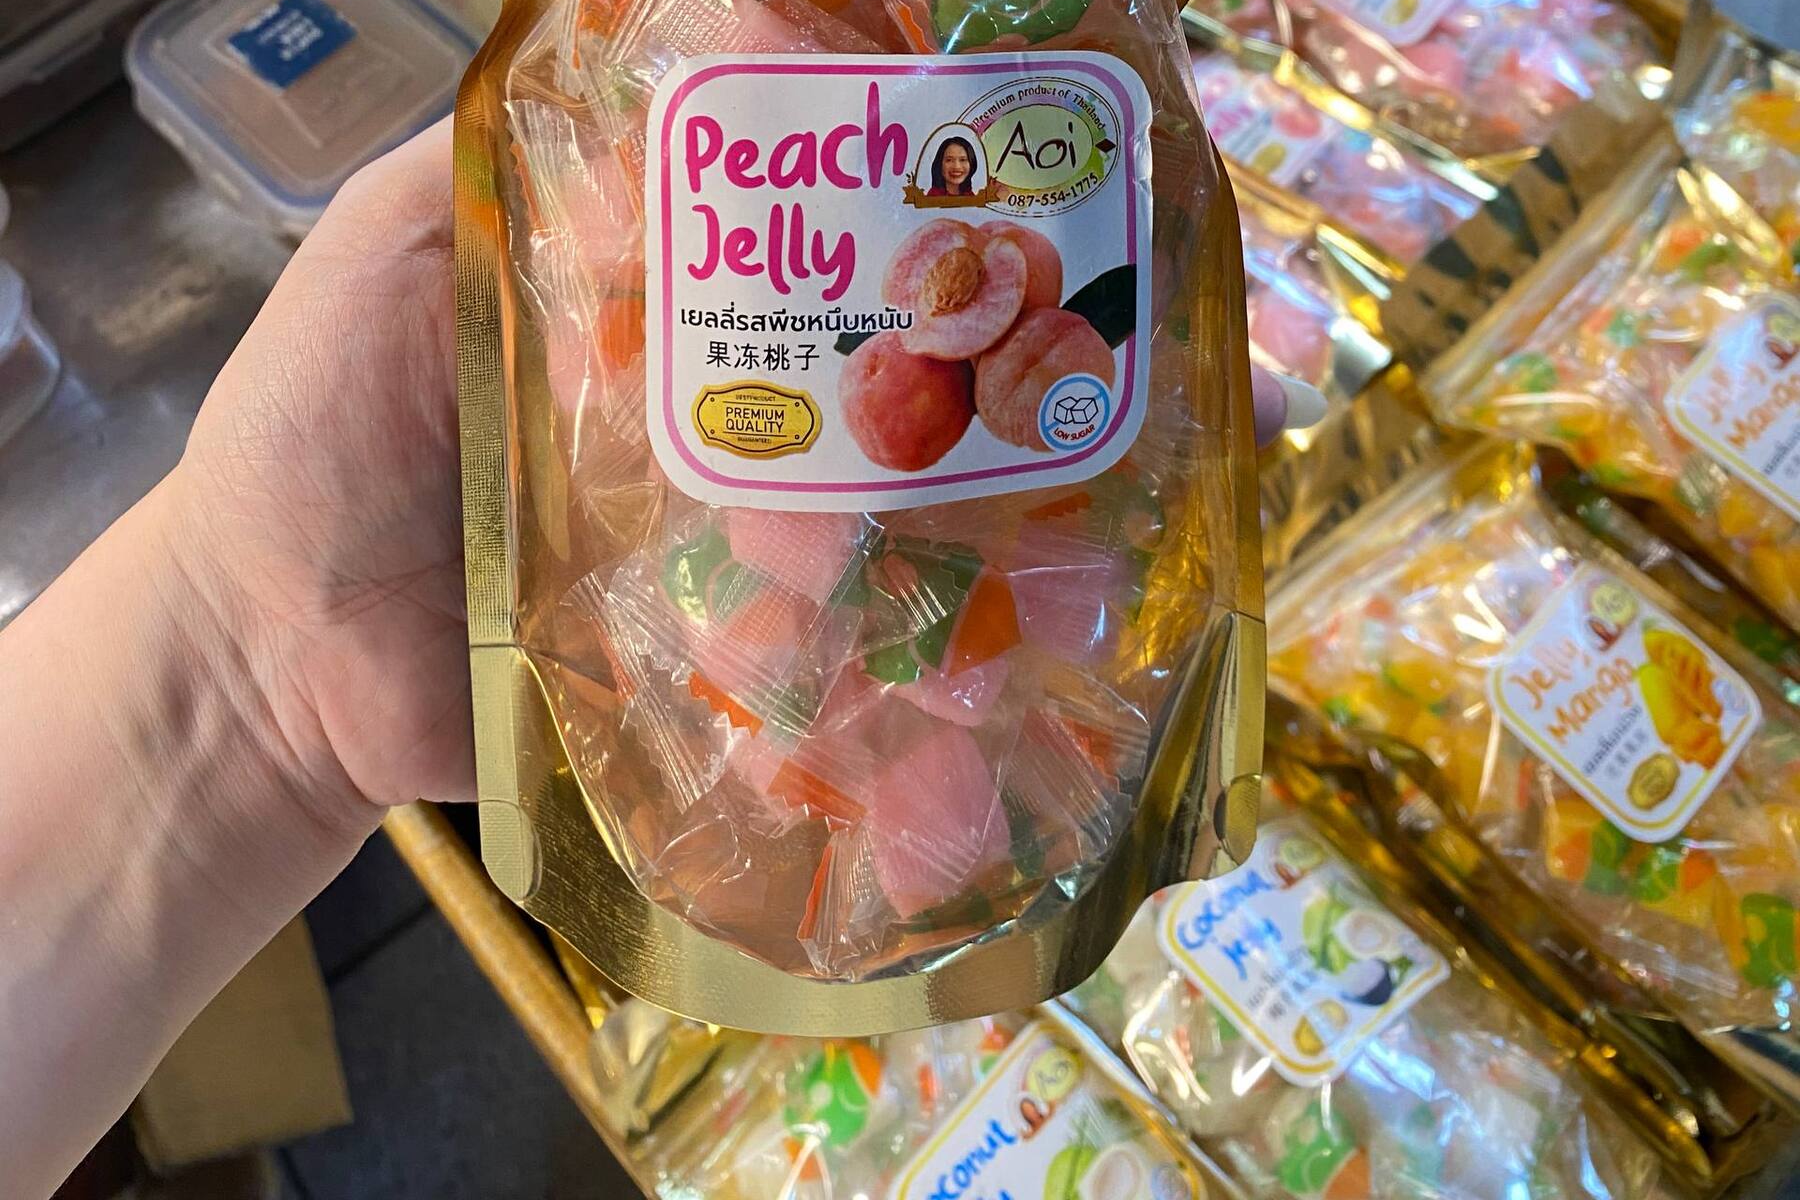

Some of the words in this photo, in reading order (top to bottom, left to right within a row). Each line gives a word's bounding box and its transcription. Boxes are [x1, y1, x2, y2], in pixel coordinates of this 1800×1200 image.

[972, 93, 1016, 129] Premium
[1017, 84, 1057, 101] product
[1057, 88, 1072, 99] of
[685, 81, 909, 194] Peach
[996, 119, 1078, 174] Aoi
[1007, 171, 1099, 207] 087-554-1775
[687, 202, 857, 301] Jelly
[681, 301, 914, 333] เยลลี่รสพีชหนึบหนับ
[705, 340, 821, 372] 果冻桃子
[725, 406, 785, 421] PREMIUM
[725, 418, 784, 433] QUALITY
[1053, 427, 1071, 441] LOW
[1070, 423, 1096, 441] SUGAR
